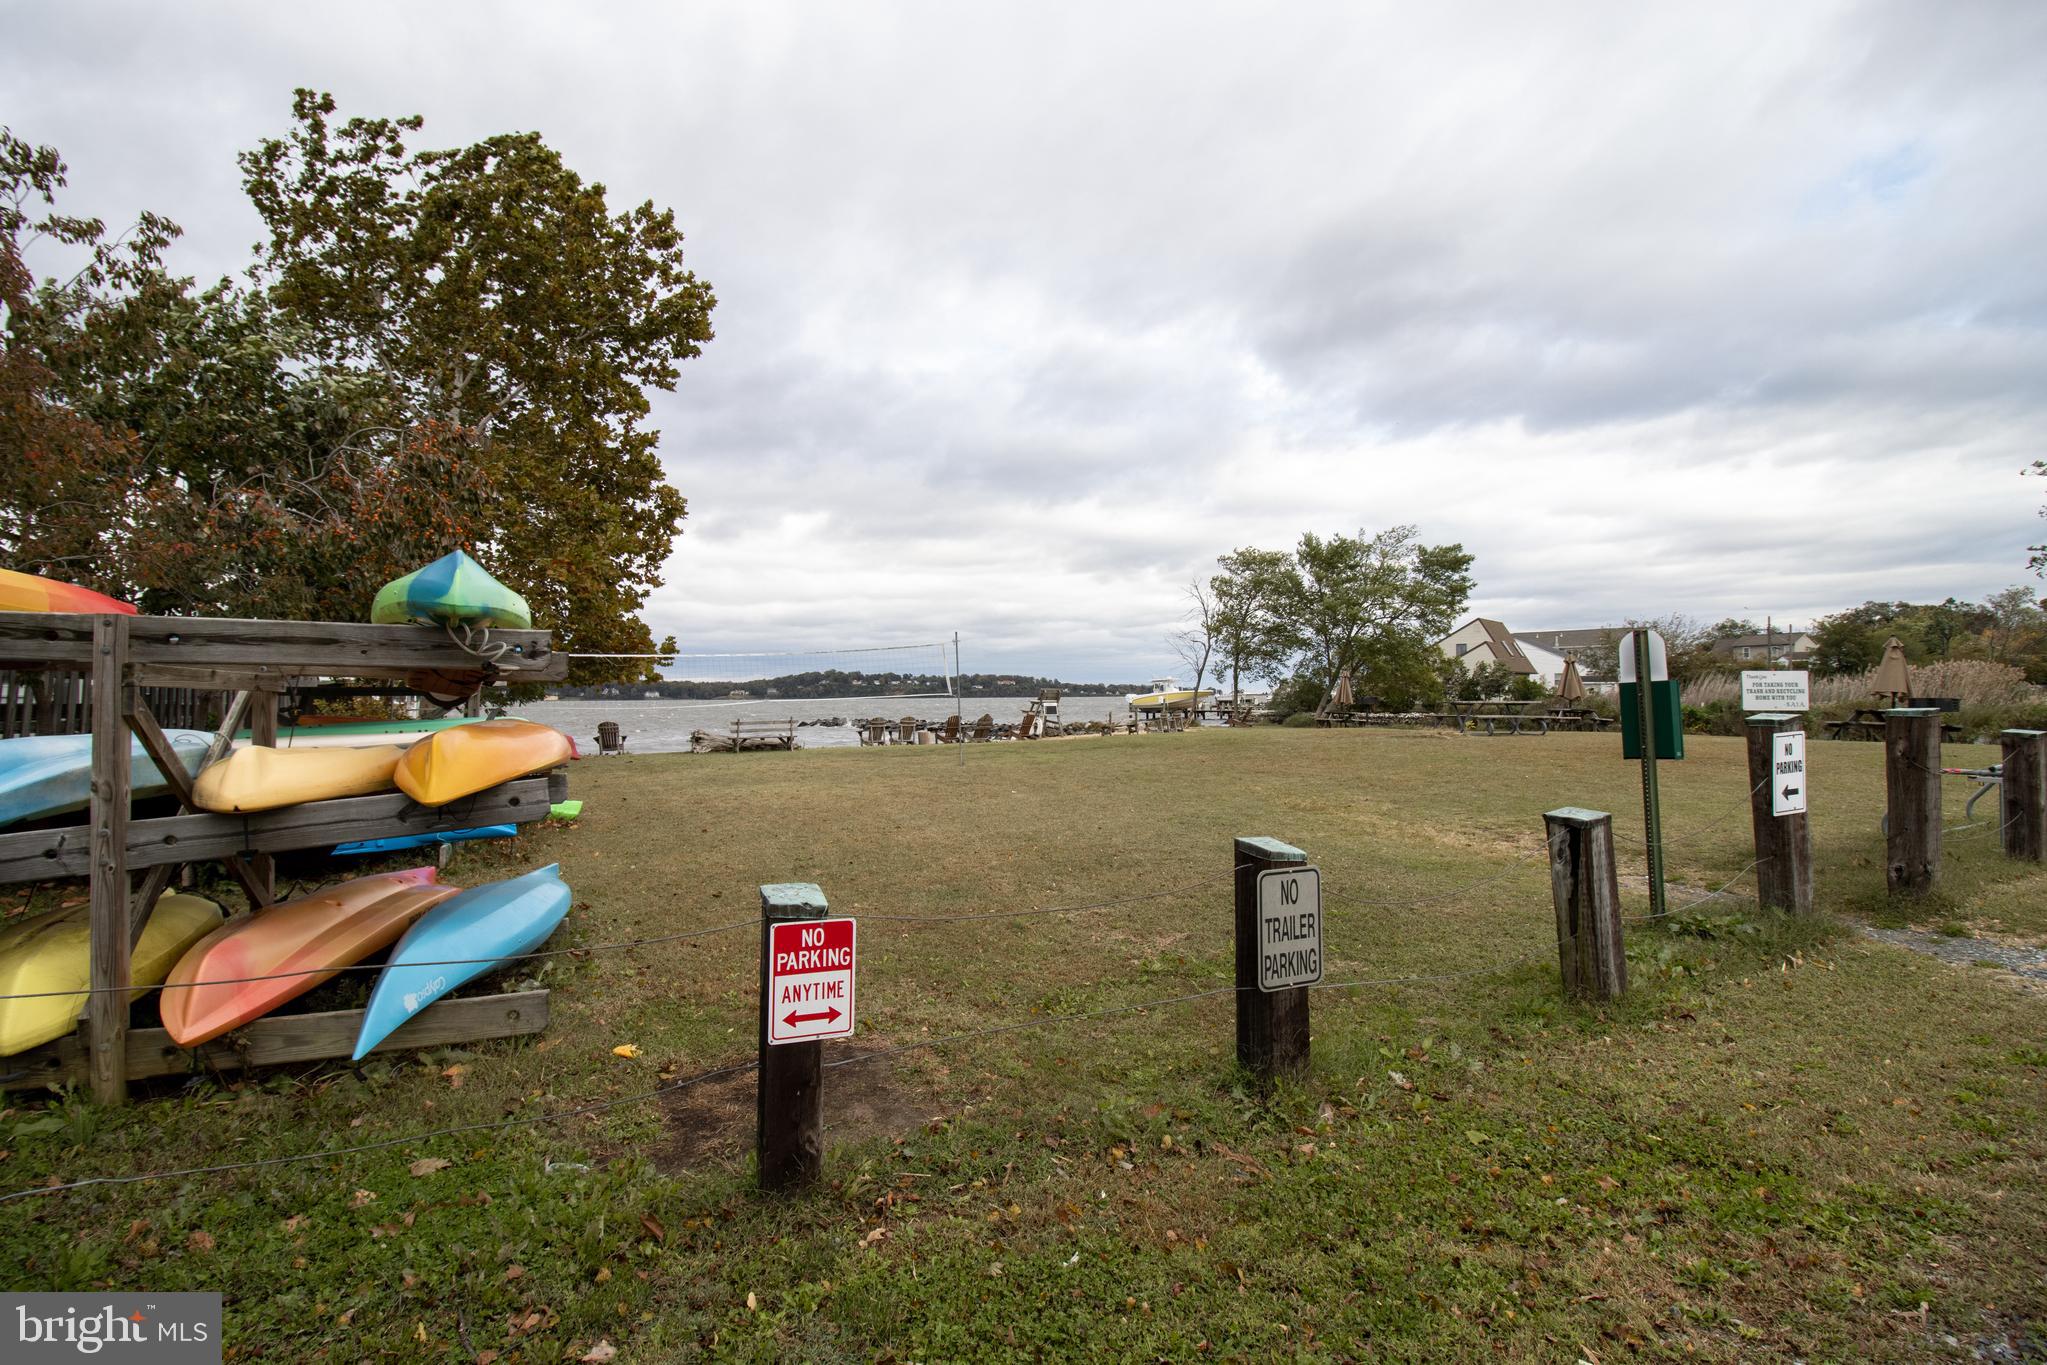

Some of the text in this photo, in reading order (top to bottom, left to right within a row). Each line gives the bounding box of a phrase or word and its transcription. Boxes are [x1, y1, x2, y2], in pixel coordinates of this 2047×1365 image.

[1784, 742, 1793, 756] NO
[1776, 760, 1803, 775] PARKING
[1280, 878, 1299, 905] NO
[801, 927, 825, 948] NO
[1265, 913, 1316, 943] TRAILER
[776, 947, 851, 972] PARKING
[1264, 948, 1317, 981] PARKING
[781, 980, 845, 1004] ANYTIME
